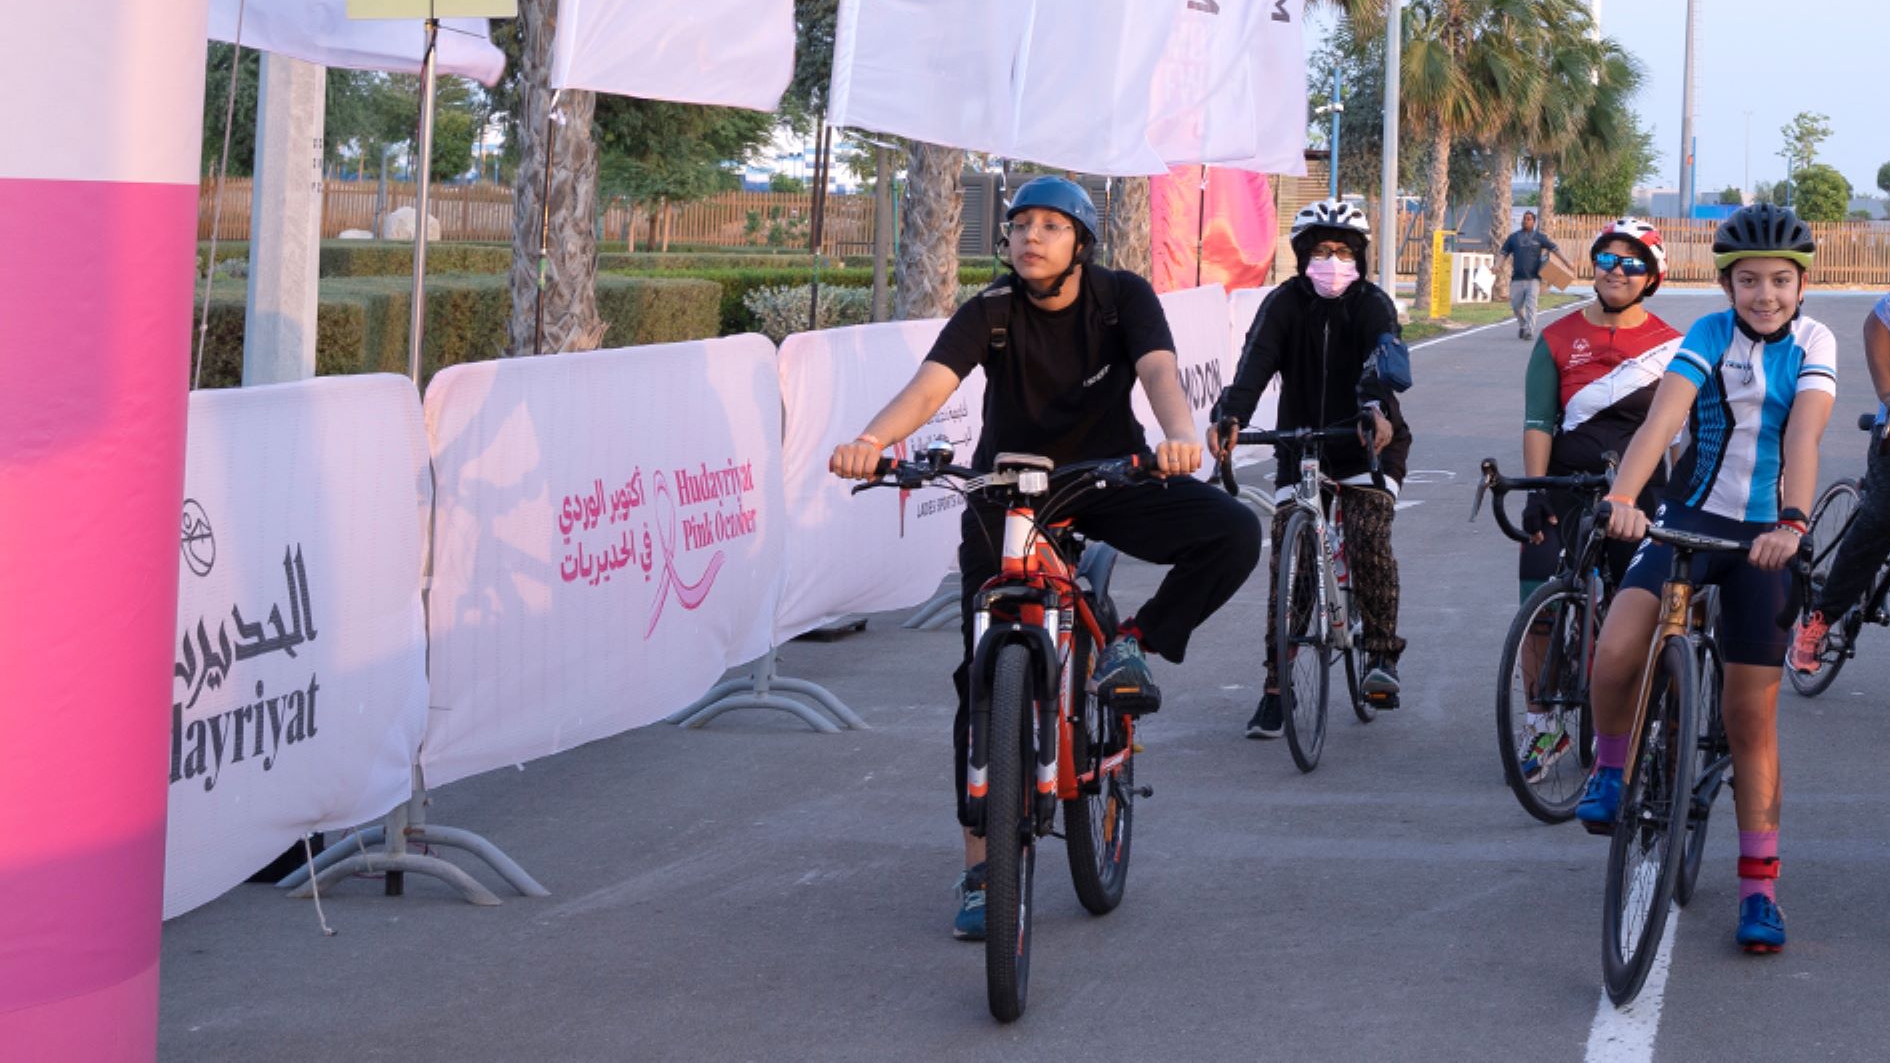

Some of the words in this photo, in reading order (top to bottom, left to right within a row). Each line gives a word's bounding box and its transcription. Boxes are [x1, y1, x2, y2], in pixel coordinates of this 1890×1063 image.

[559, 478, 606, 545] الوردي
[609, 465, 646, 525] أكتوبر
[673, 458, 754, 507] Hudayriyat
[561, 529, 636, 586] الحديريات
[640, 521, 652, 582] في
[682, 512, 714, 552] Pink
[715, 503, 757, 542] October
[169, 672, 320, 792] ayriyat
